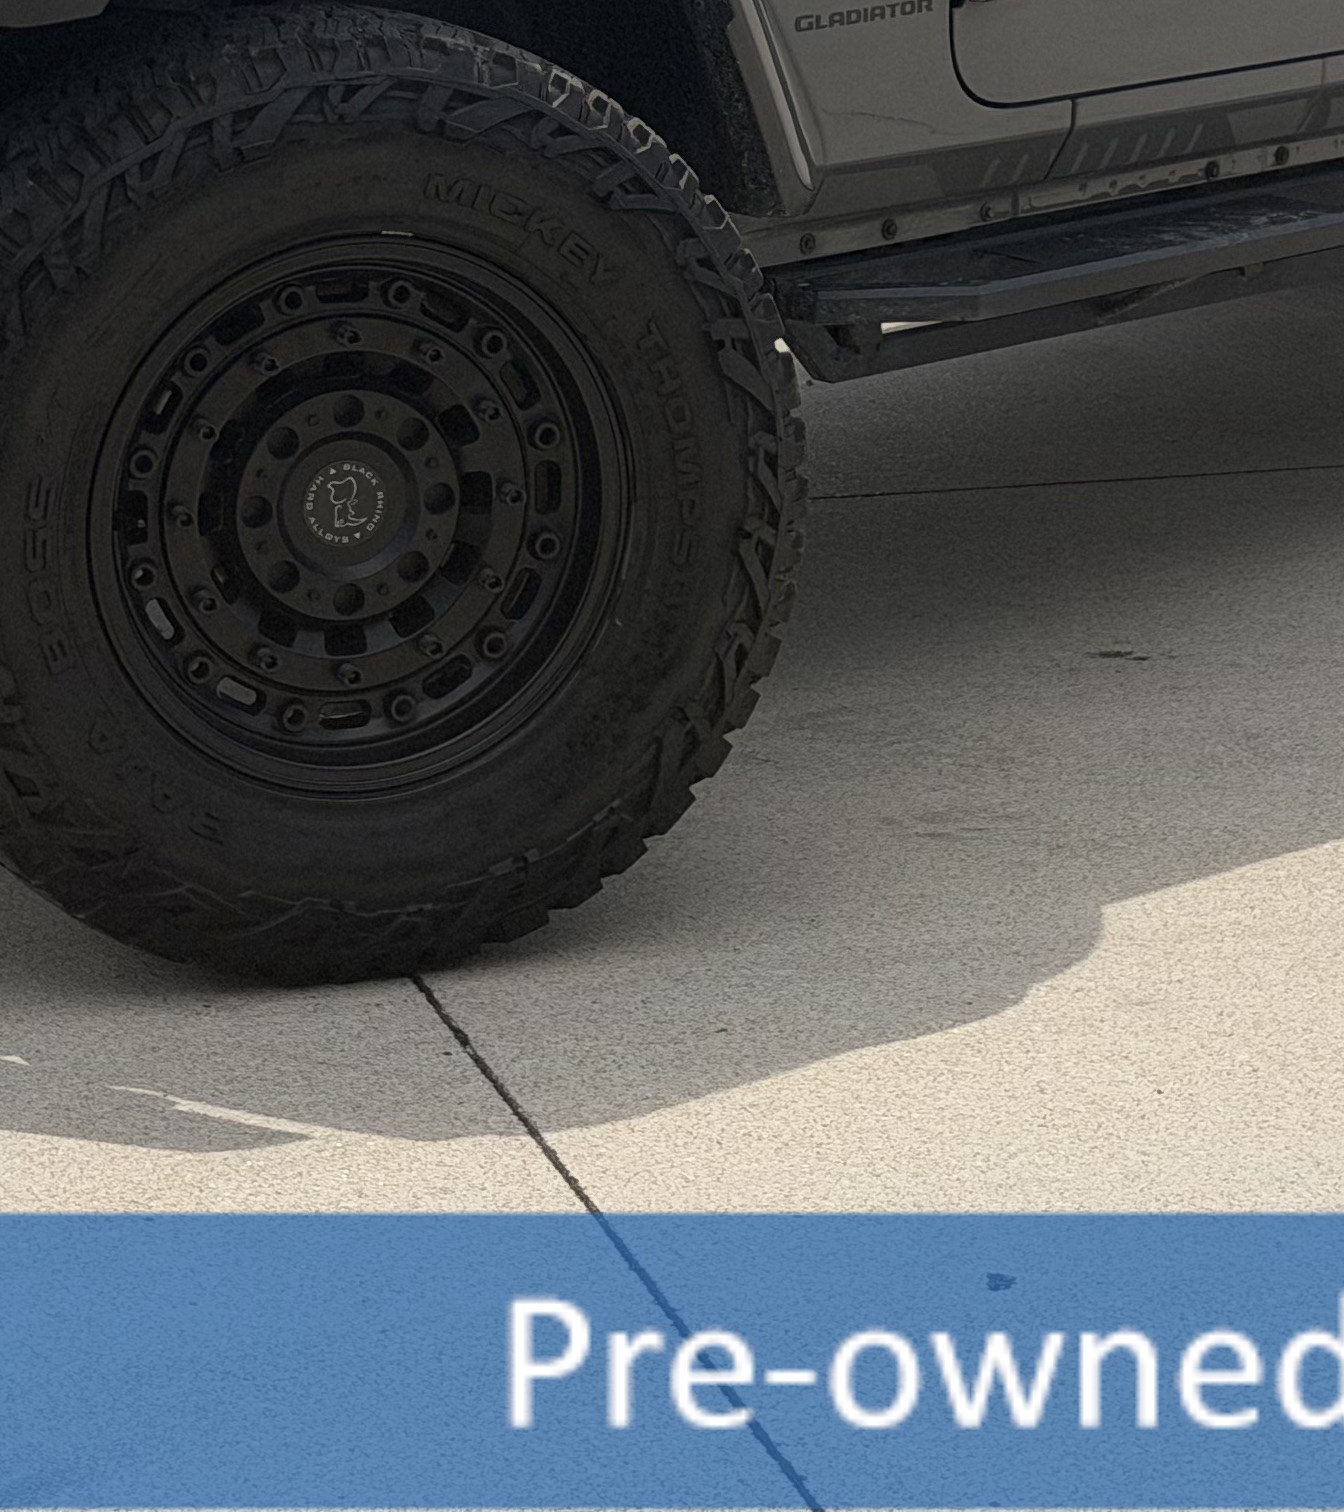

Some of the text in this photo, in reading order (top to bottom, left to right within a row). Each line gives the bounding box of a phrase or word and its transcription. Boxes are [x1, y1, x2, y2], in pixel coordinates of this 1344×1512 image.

[343, 463, 379, 486] BLACK
[423, 172, 703, 638] MICKEY THOMPSO
